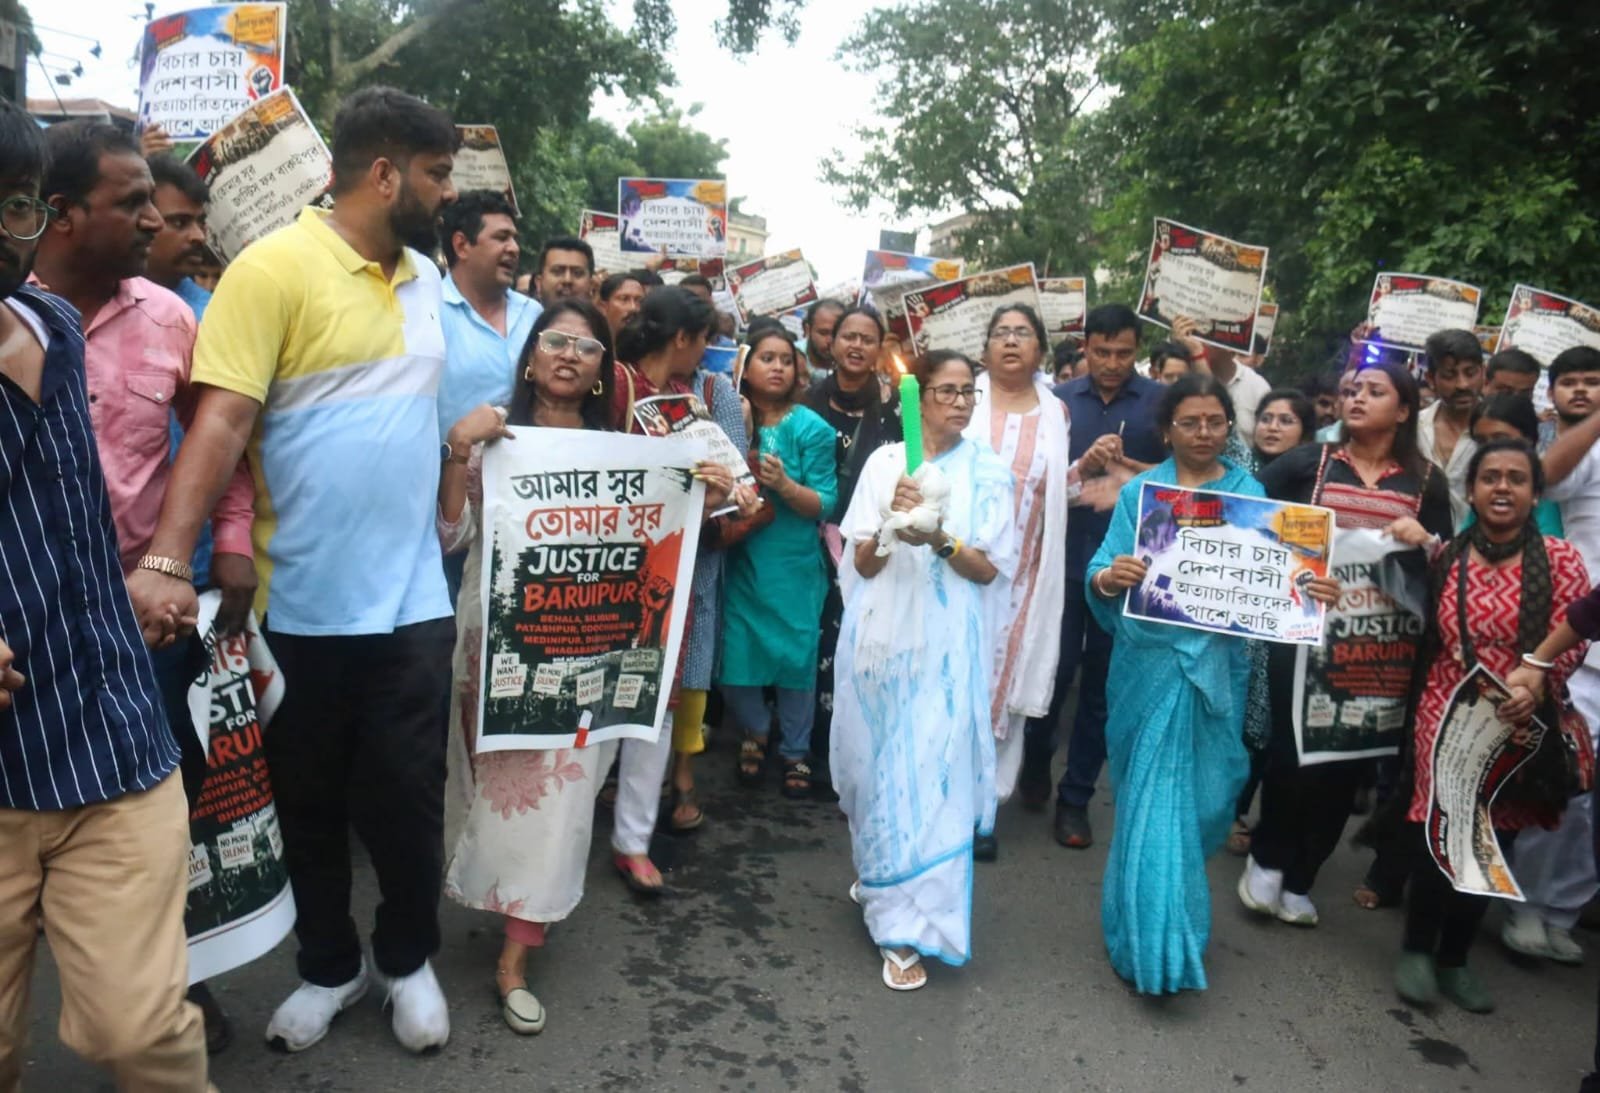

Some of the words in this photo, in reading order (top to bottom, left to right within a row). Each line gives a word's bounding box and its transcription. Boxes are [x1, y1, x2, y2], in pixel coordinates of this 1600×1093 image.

[157, 50, 199, 72] বিচার
[208, 50, 244, 68] চায়
[154, 69, 239, 95] দেশবাসী
[510, 468, 600, 500] আমার
[607, 469, 648, 504] সুর
[526, 504, 622, 540] তোমার
[627, 503, 665, 538] সুর
[1180, 529, 1242, 559] বিচার
[1251, 544, 1288, 567] চায়
[528, 546, 640, 575] JUSTICE
[577, 573, 599, 583] FOR
[1178, 560, 1284, 590] দেশবাসী
[524, 581, 638, 612] BARUIPUR
[1175, 581, 1295, 612] অত্যাচারিতদের
[1184, 603, 1231, 623] পাশে
[1237, 611, 1280, 634] আছি
[1336, 615, 1424, 638] JUSTIC
[496, 665, 518, 675] WANT
[501, 656, 513, 665] WE
[493, 675, 523, 688] JUSTICE
[536, 676, 560, 686] SILENCE
[226, 710, 257, 732] FOR
[220, 837, 230, 848] NO
[231, 834, 248, 845] MORE
